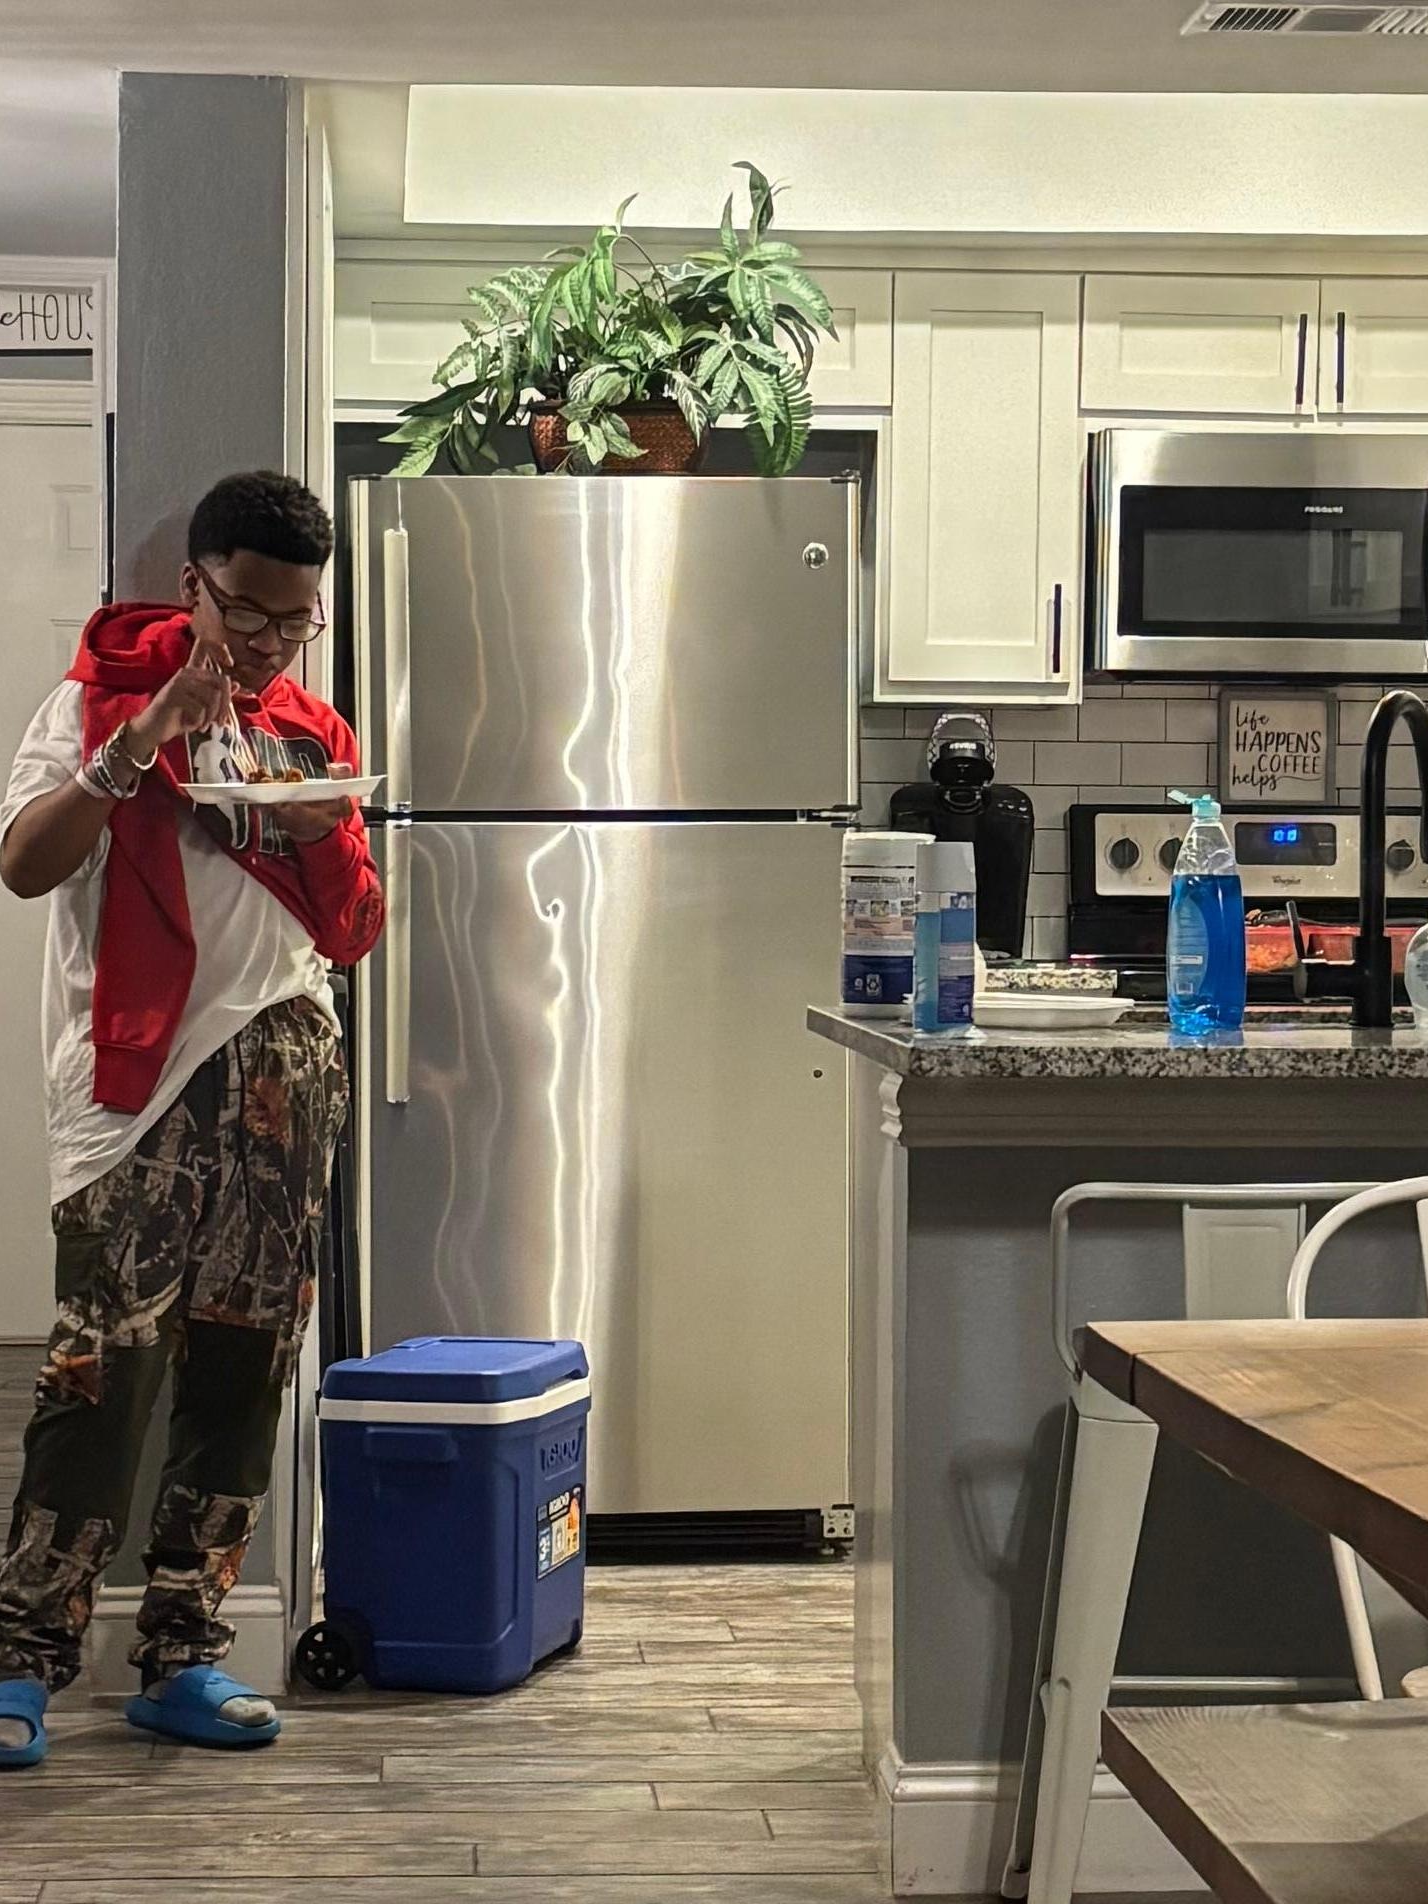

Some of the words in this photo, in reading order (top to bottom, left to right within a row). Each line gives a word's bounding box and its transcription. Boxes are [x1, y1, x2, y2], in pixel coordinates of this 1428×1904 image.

[1236, 730, 1322, 754] HAPPENS
[1258, 754, 1320, 774] COFFEE
[1232, 764, 1278, 796] helps
